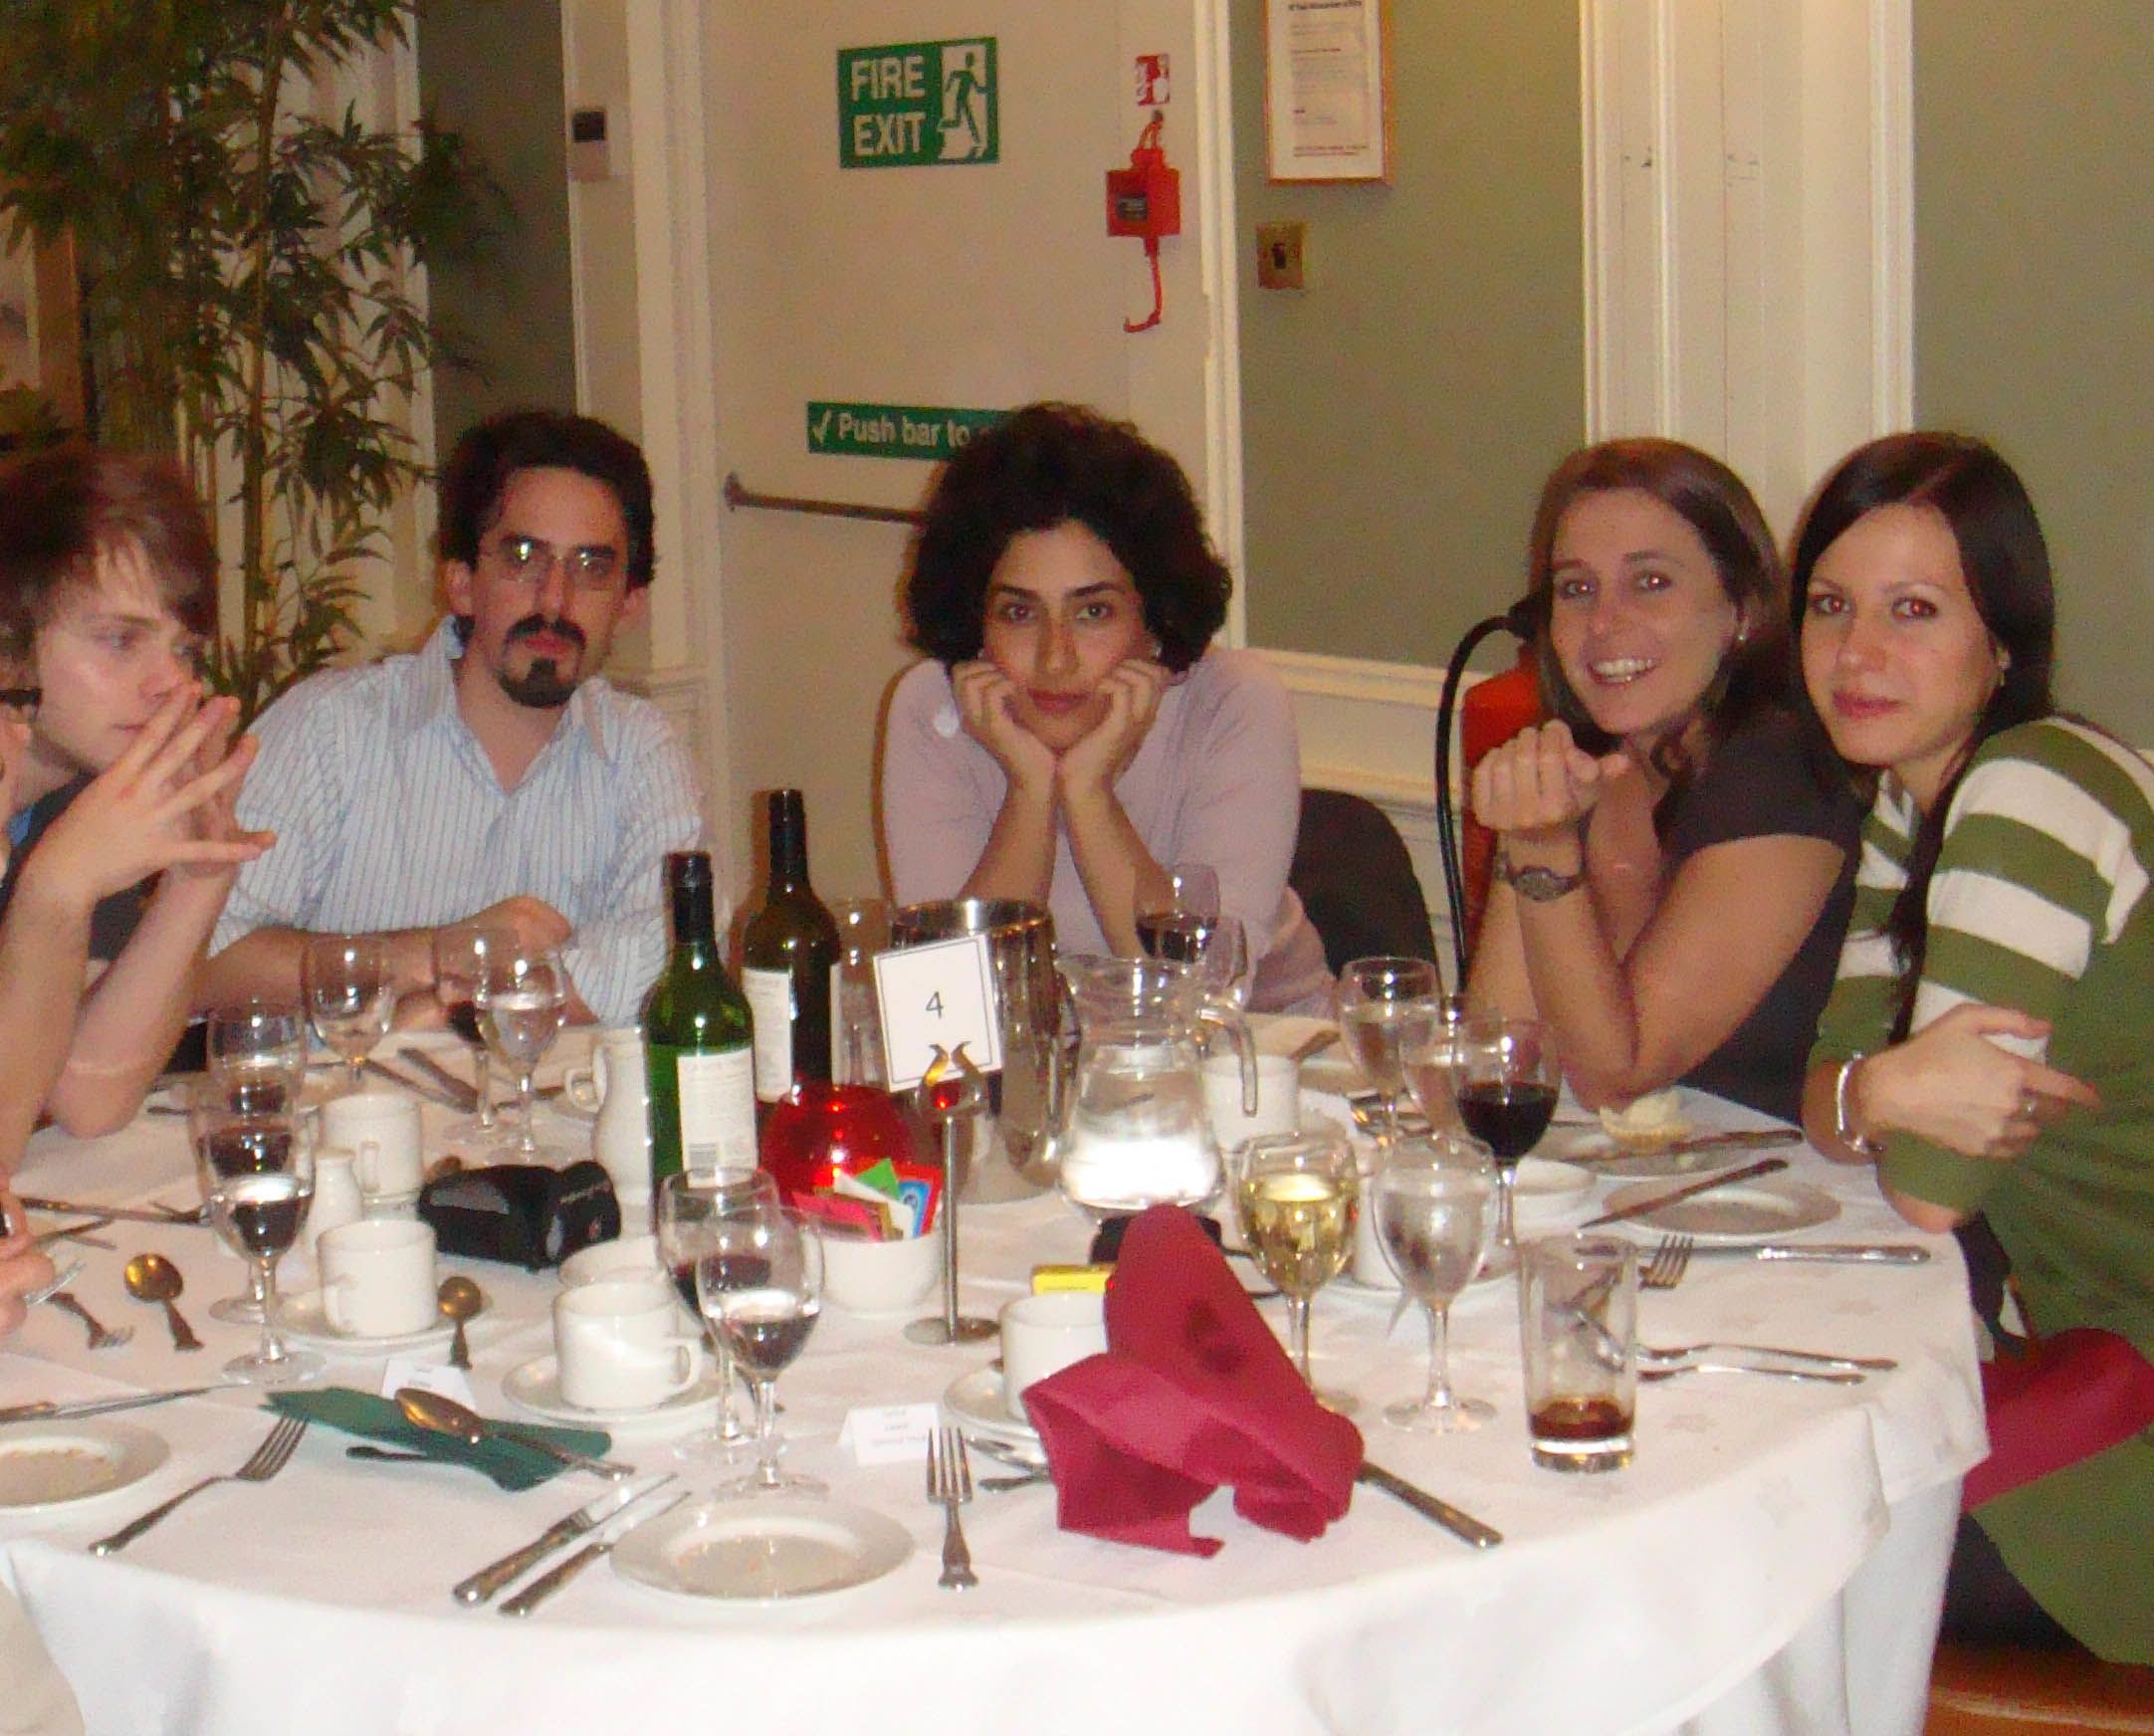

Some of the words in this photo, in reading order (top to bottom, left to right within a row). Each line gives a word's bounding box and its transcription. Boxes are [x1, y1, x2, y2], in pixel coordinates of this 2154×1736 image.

[851, 55, 926, 102] FIRE
[853, 111, 927, 157] EXIT
[838, 409, 896, 443] Push
[902, 414, 941, 447] bar
[947, 419, 971, 448] to
[925, 990, 944, 1019] 4
